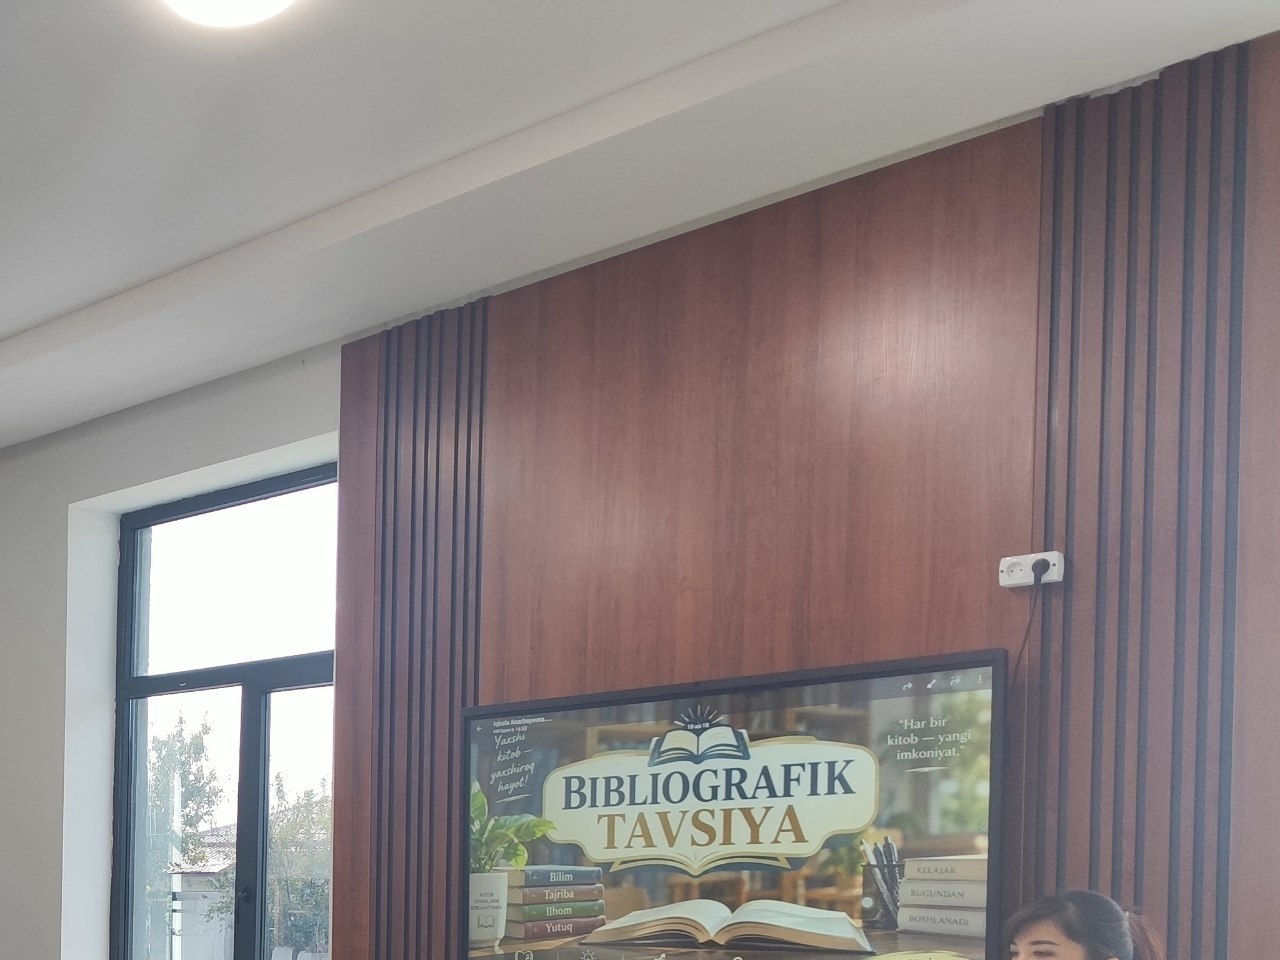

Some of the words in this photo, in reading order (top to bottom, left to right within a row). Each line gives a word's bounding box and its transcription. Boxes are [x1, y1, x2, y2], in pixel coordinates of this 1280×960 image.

[930, 717, 947, 728] bir
[494, 731, 525, 749] Yaxshi
[887, 733, 919, 745] kitob
[938, 729, 971, 745] yangi
[497, 746, 521, 762] kitob
[489, 762, 535, 784] yaxshiroq
[497, 775, 528, 794] hayot!
[562, 759, 856, 810] BIBLIOGRAFIK
[597, 804, 809, 849] TAVSIYA
[550, 872, 573, 882] Bilim
[544, 890, 574, 901] Tajriba
[911, 889, 965, 898] BUGUNDAN
[546, 907, 572, 916] Ilhom
[546, 923, 573, 933] Yutuq
[908, 915, 969, 927] BOSHLANADI
